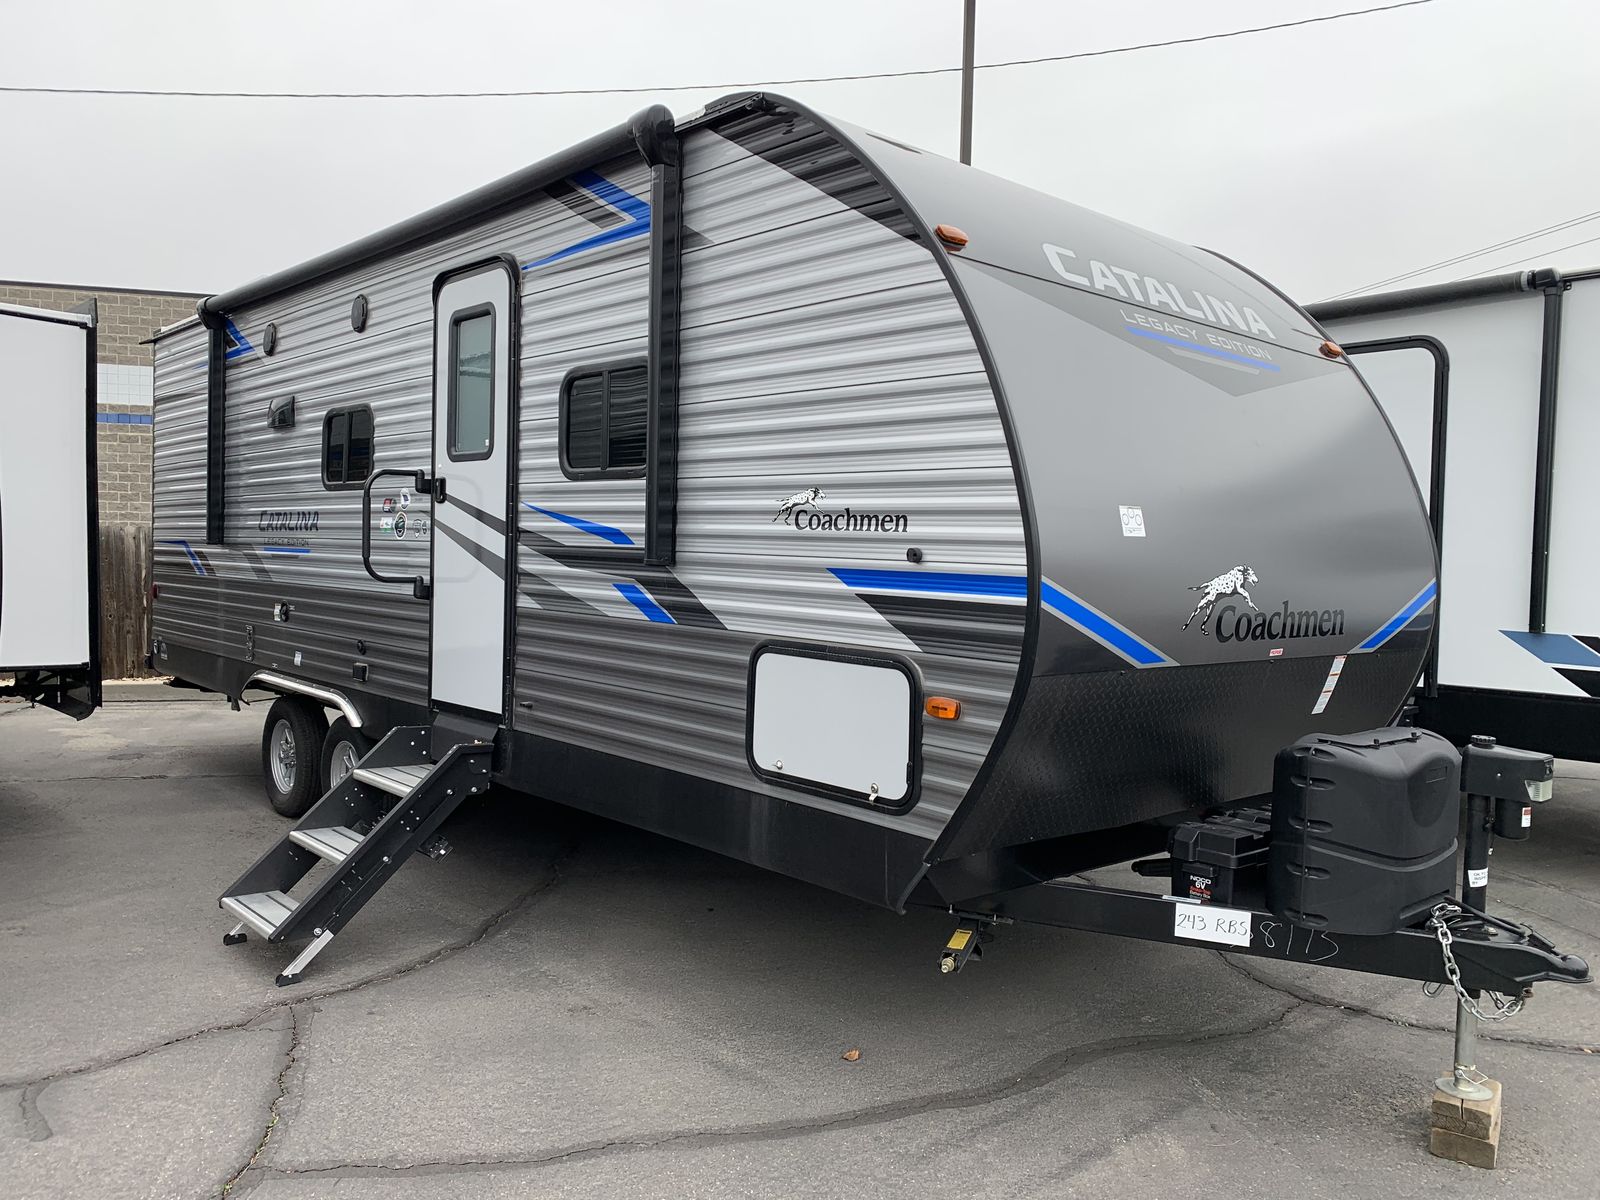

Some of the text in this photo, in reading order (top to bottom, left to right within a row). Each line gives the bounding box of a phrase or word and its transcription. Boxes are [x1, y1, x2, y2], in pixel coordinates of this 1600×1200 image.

[1042, 243, 1277, 340] CATALINA
[1119, 308, 1273, 361] LEGACY EDITION
[258, 510, 319, 531] CATALINA
[794, 507, 908, 533] Coachmen
[1215, 600, 1345, 643] Coachmen
[1189, 875, 1212, 885] NOCO
[1195, 881, 1206, 890] 6V
[1176, 913, 1207, 931] 243
[1215, 917, 1249, 937] RBS
